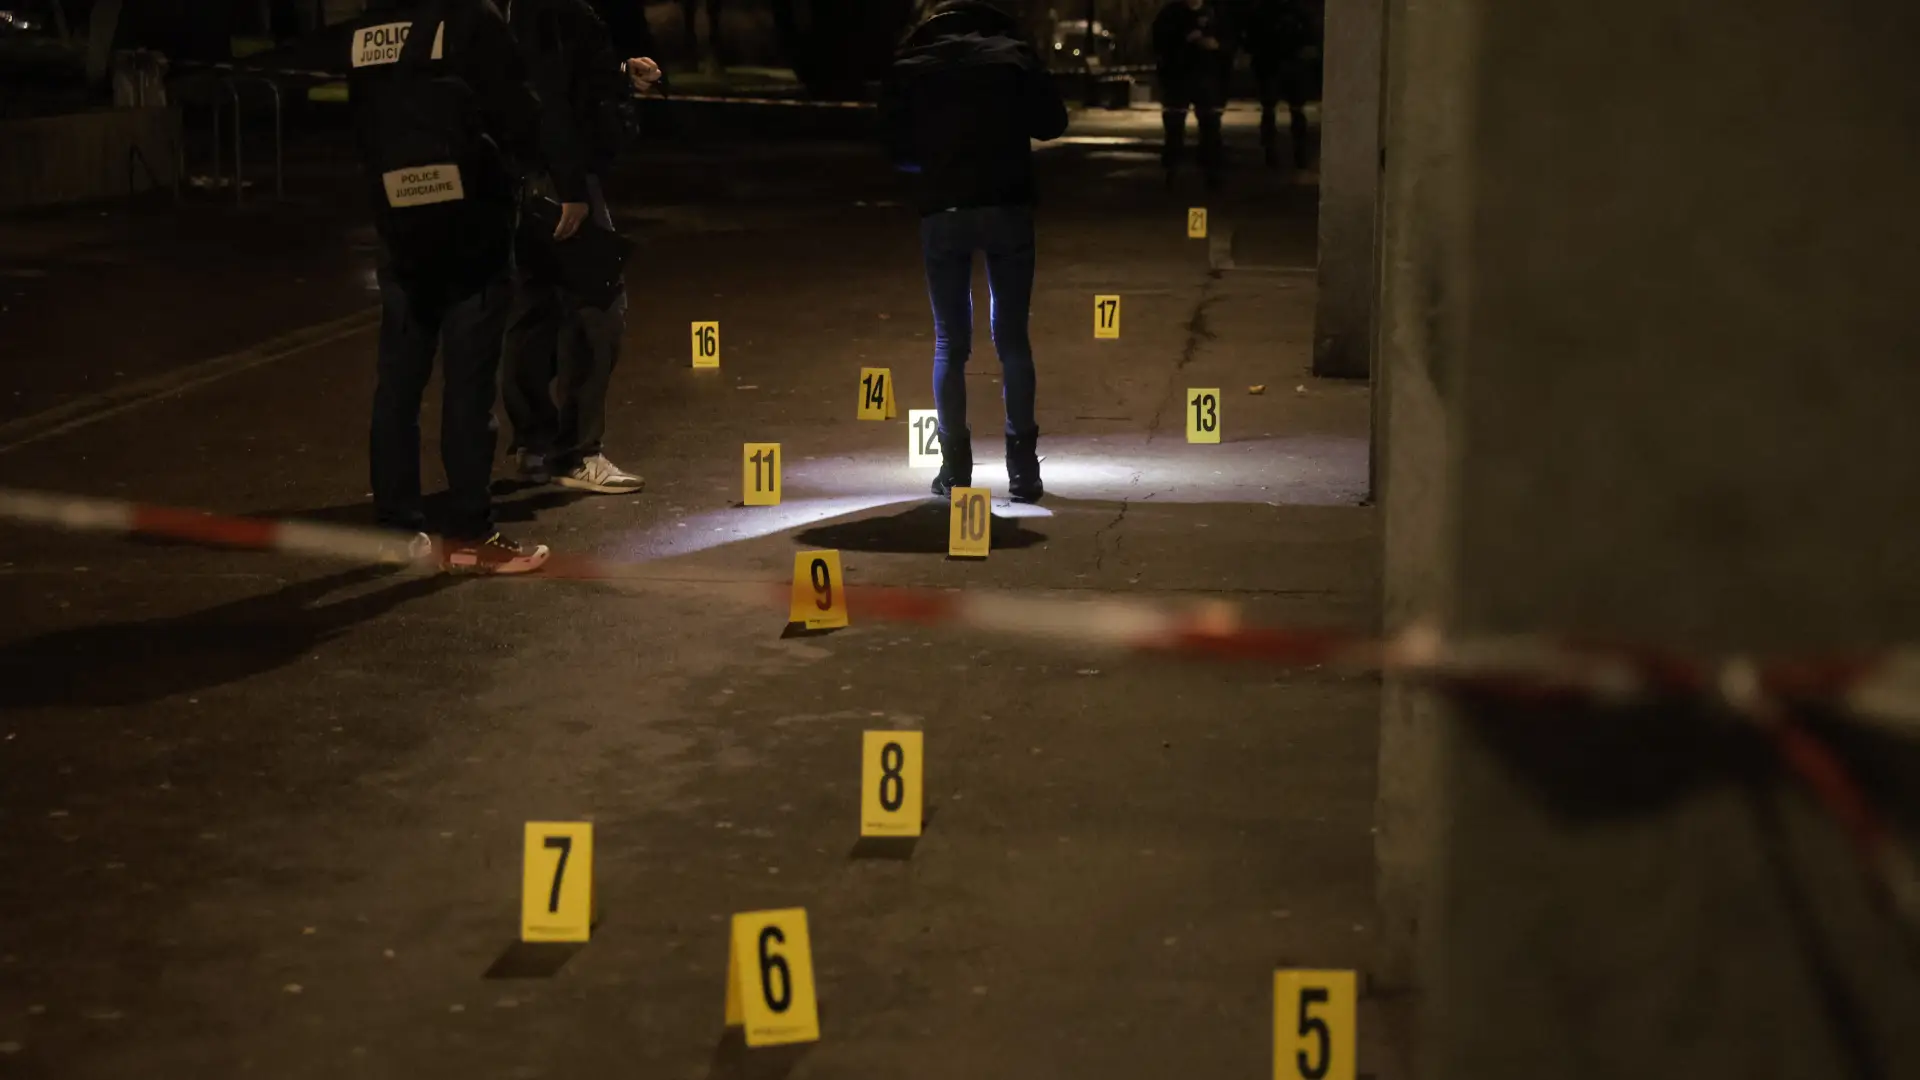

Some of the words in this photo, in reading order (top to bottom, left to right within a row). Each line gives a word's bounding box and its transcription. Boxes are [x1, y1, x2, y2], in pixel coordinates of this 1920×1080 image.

[396, 181, 454, 198] JUDICIAIRE
[401, 170, 440, 184] POLICE
[1191, 211, 1204, 231] 21
[1097, 300, 1117, 328] 17
[695, 326, 716, 357] 16
[863, 374, 884, 410] 14
[1191, 394, 1217, 432] 13
[913, 416, 939, 455] 12
[749, 449, 775, 492] 11
[955, 494, 985, 540] 10
[810, 558, 831, 611] 9
[879, 742, 904, 812] 8
[544, 836, 571, 913] 7
[759, 924, 792, 1014] 6
[1297, 987, 1331, 1080] 5
